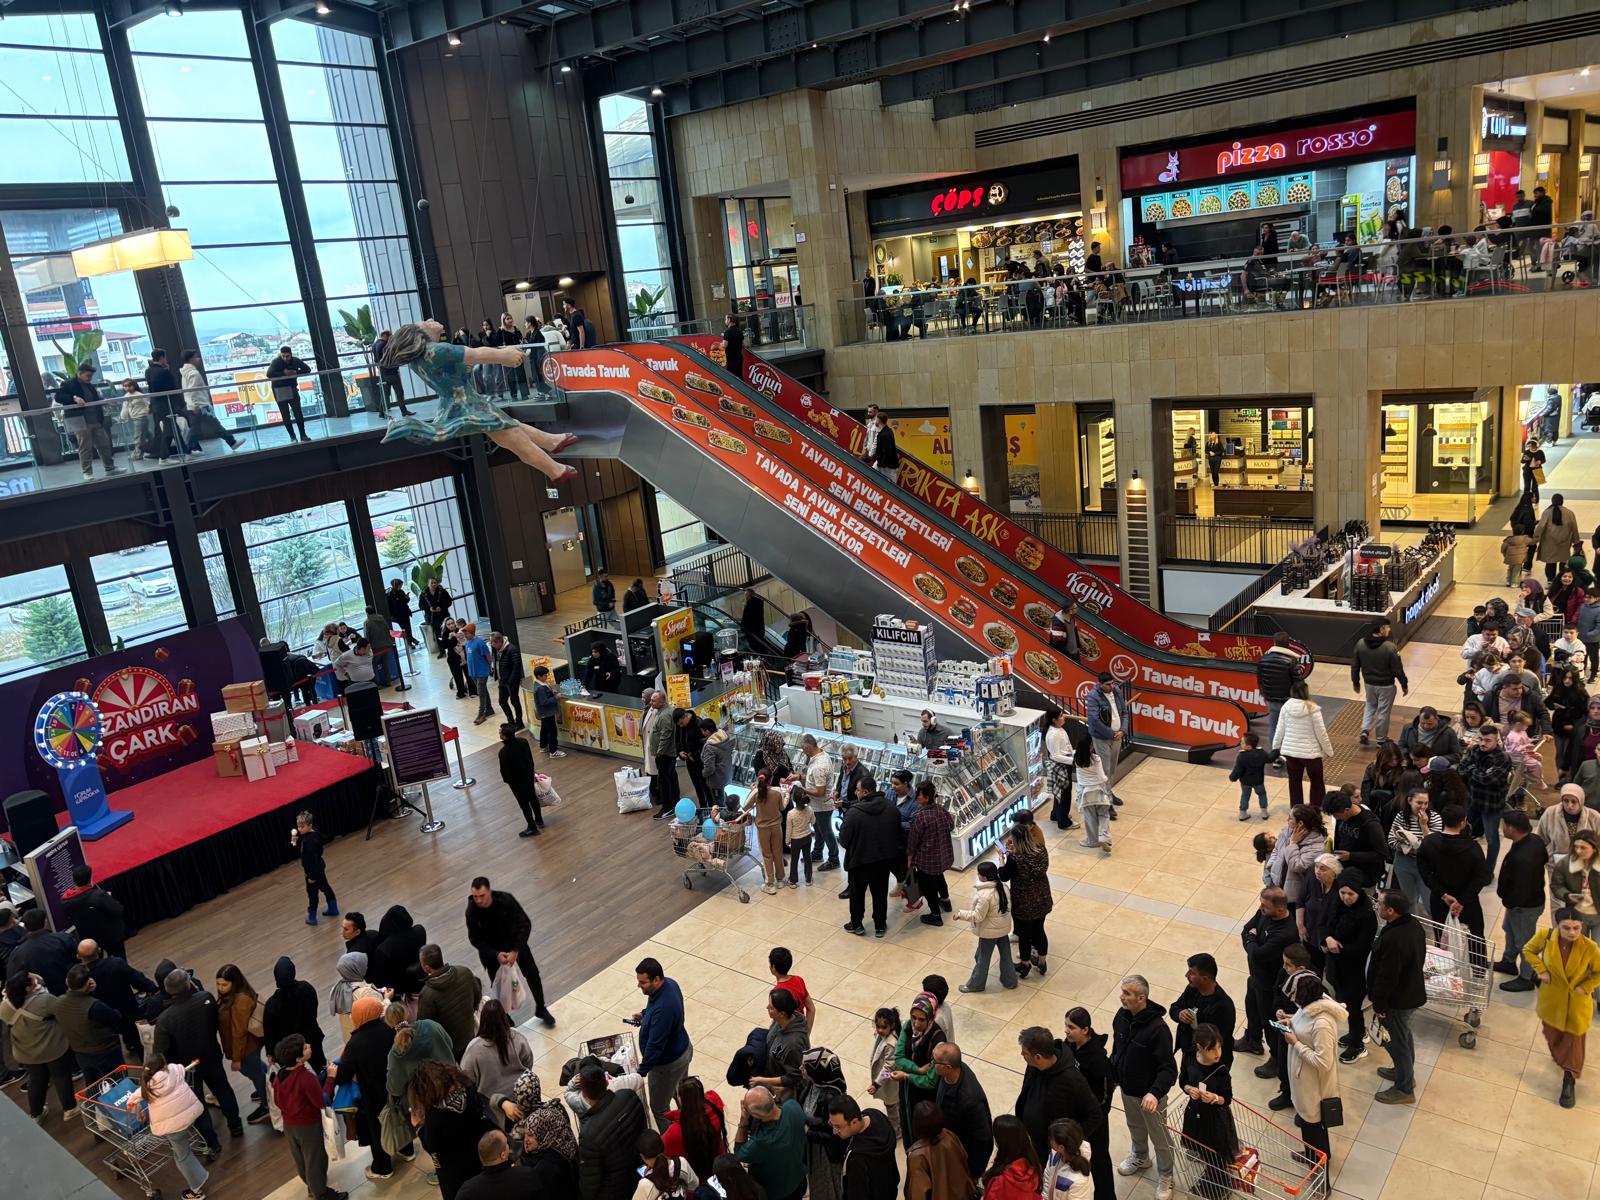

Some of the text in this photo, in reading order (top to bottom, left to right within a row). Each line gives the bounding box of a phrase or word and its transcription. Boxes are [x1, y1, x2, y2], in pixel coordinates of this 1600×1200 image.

[1217, 129, 1374, 174] pizza rosso
[561, 364, 631, 378] Tavada Tavuk
[646, 358, 679, 372] Tavuk
[748, 363, 783, 394] Kajun
[756, 452, 912, 568] TAVADA TAVUK LEZZETLERİ
[800, 442, 954, 552] TAVADA TAVUK LEZZETLERİ
[828, 481, 907, 541] SENİ BEKLİYOR
[783, 493, 864, 555] SENİ BEKLİYOR
[1067, 572, 1114, 608] Kajun
[665, 616, 688, 636] Sweet
[876, 628, 918, 643] KILIFCIM
[1142, 666, 1266, 707] Tavada Tavuk
[101, 694, 198, 737] ZANDIRAN
[572, 705, 595, 718] Sweet
[1131, 700, 1240, 738] vada Tavuk
[110, 723, 177, 764] ÇARK
